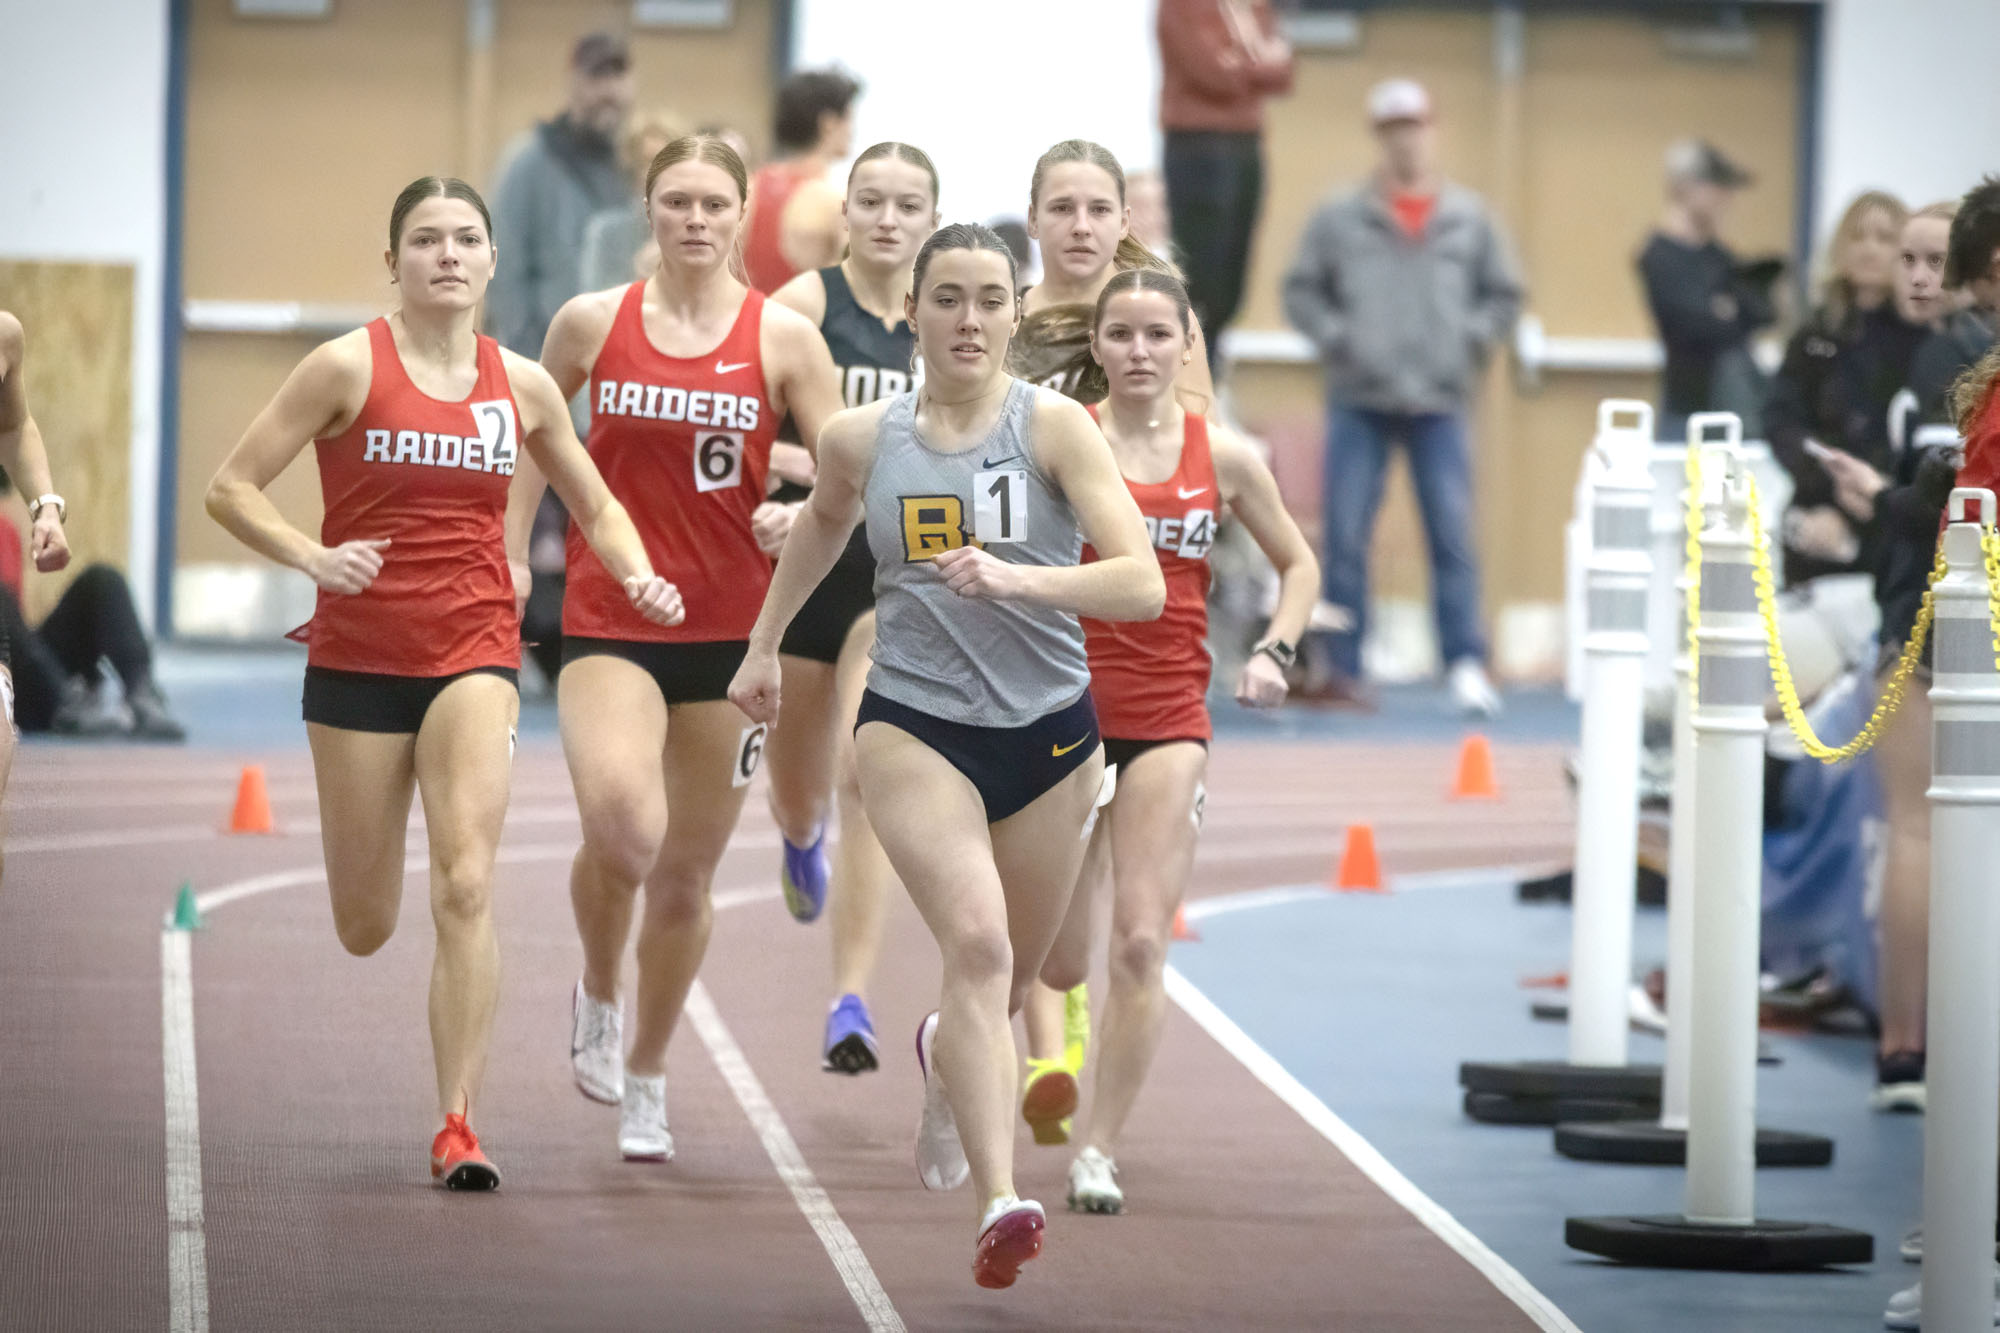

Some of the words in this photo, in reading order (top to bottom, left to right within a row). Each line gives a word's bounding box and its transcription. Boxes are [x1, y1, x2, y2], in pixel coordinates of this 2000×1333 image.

[597, 380, 760, 431] RAIDERS
[363, 429, 515, 476] RAIDE
[483, 406, 511, 459] 2
[700, 434, 735, 482] 6
[988, 475, 1011, 538] 1
[1186, 514, 1211, 555] 4
[741, 727, 765, 778] 6
